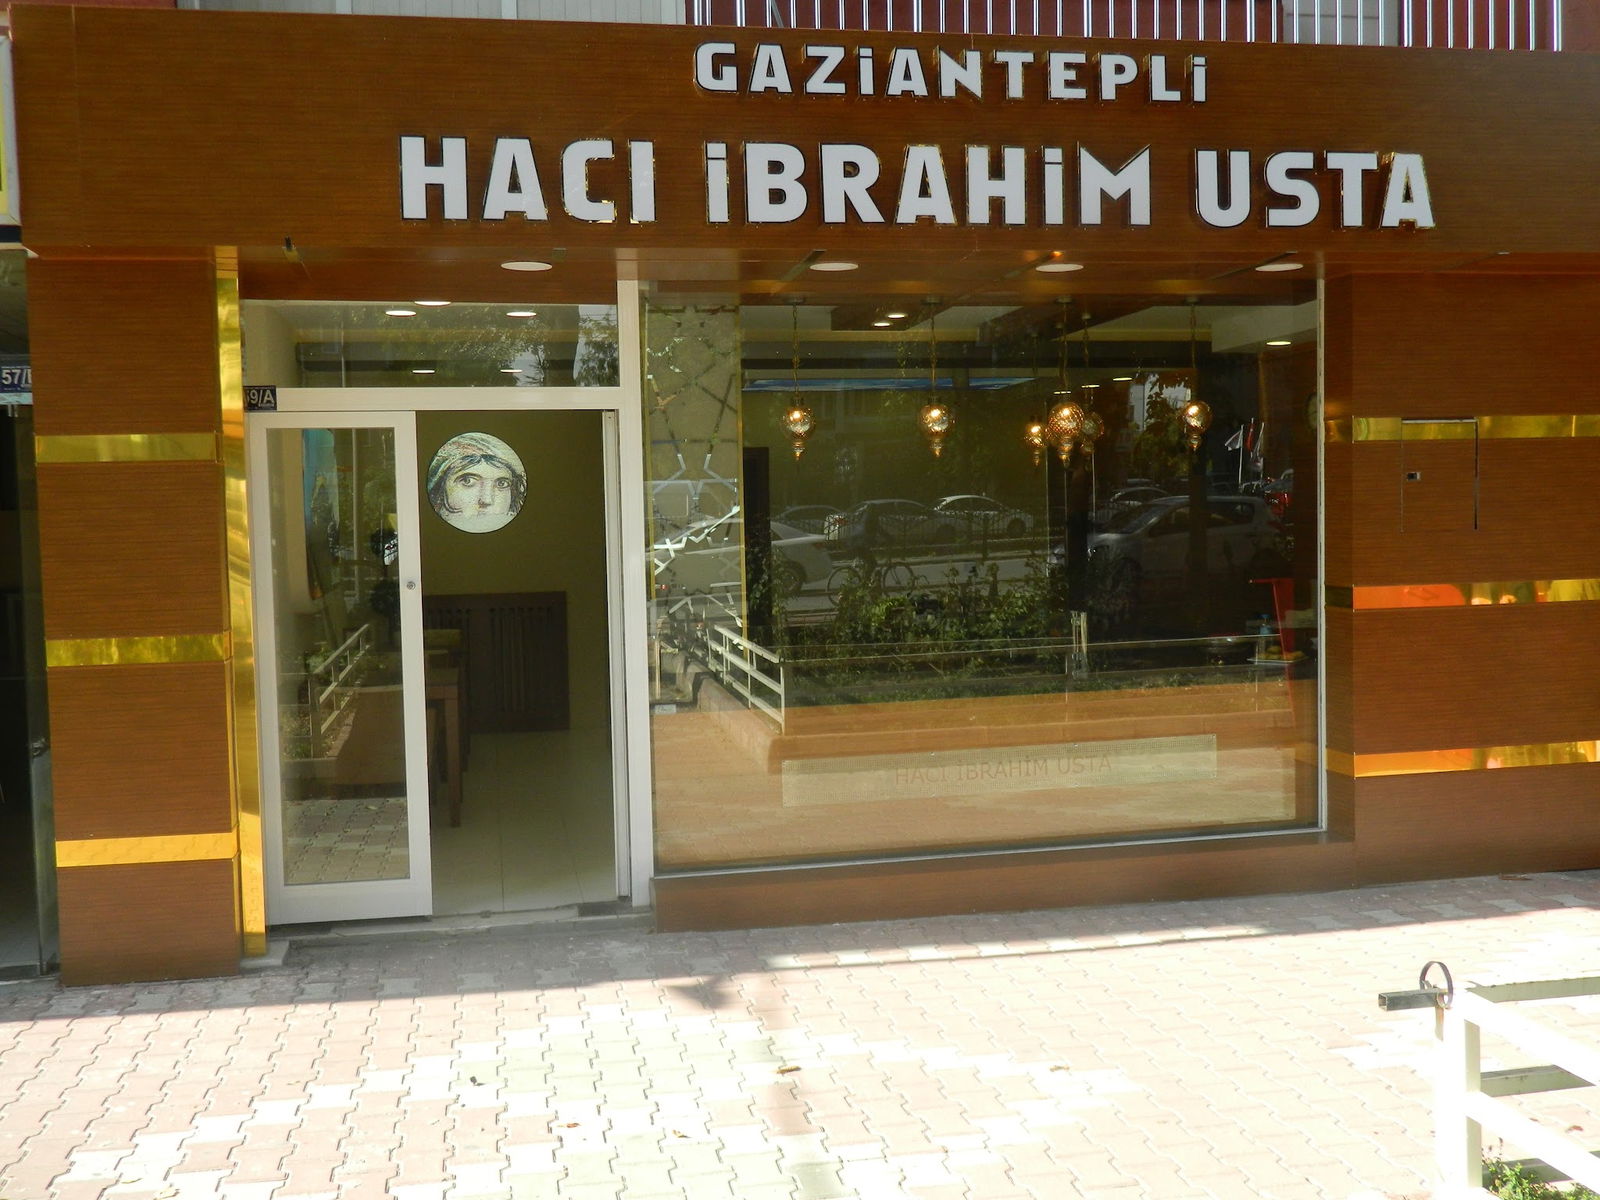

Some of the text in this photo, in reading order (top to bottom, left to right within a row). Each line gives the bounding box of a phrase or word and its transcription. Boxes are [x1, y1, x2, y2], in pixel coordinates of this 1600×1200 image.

[399, 135, 656, 225] HACI
[1194, 148, 1436, 229] USTA
[895, 767, 948, 785] HACI
[1057, 753, 1112, 774] USTA
